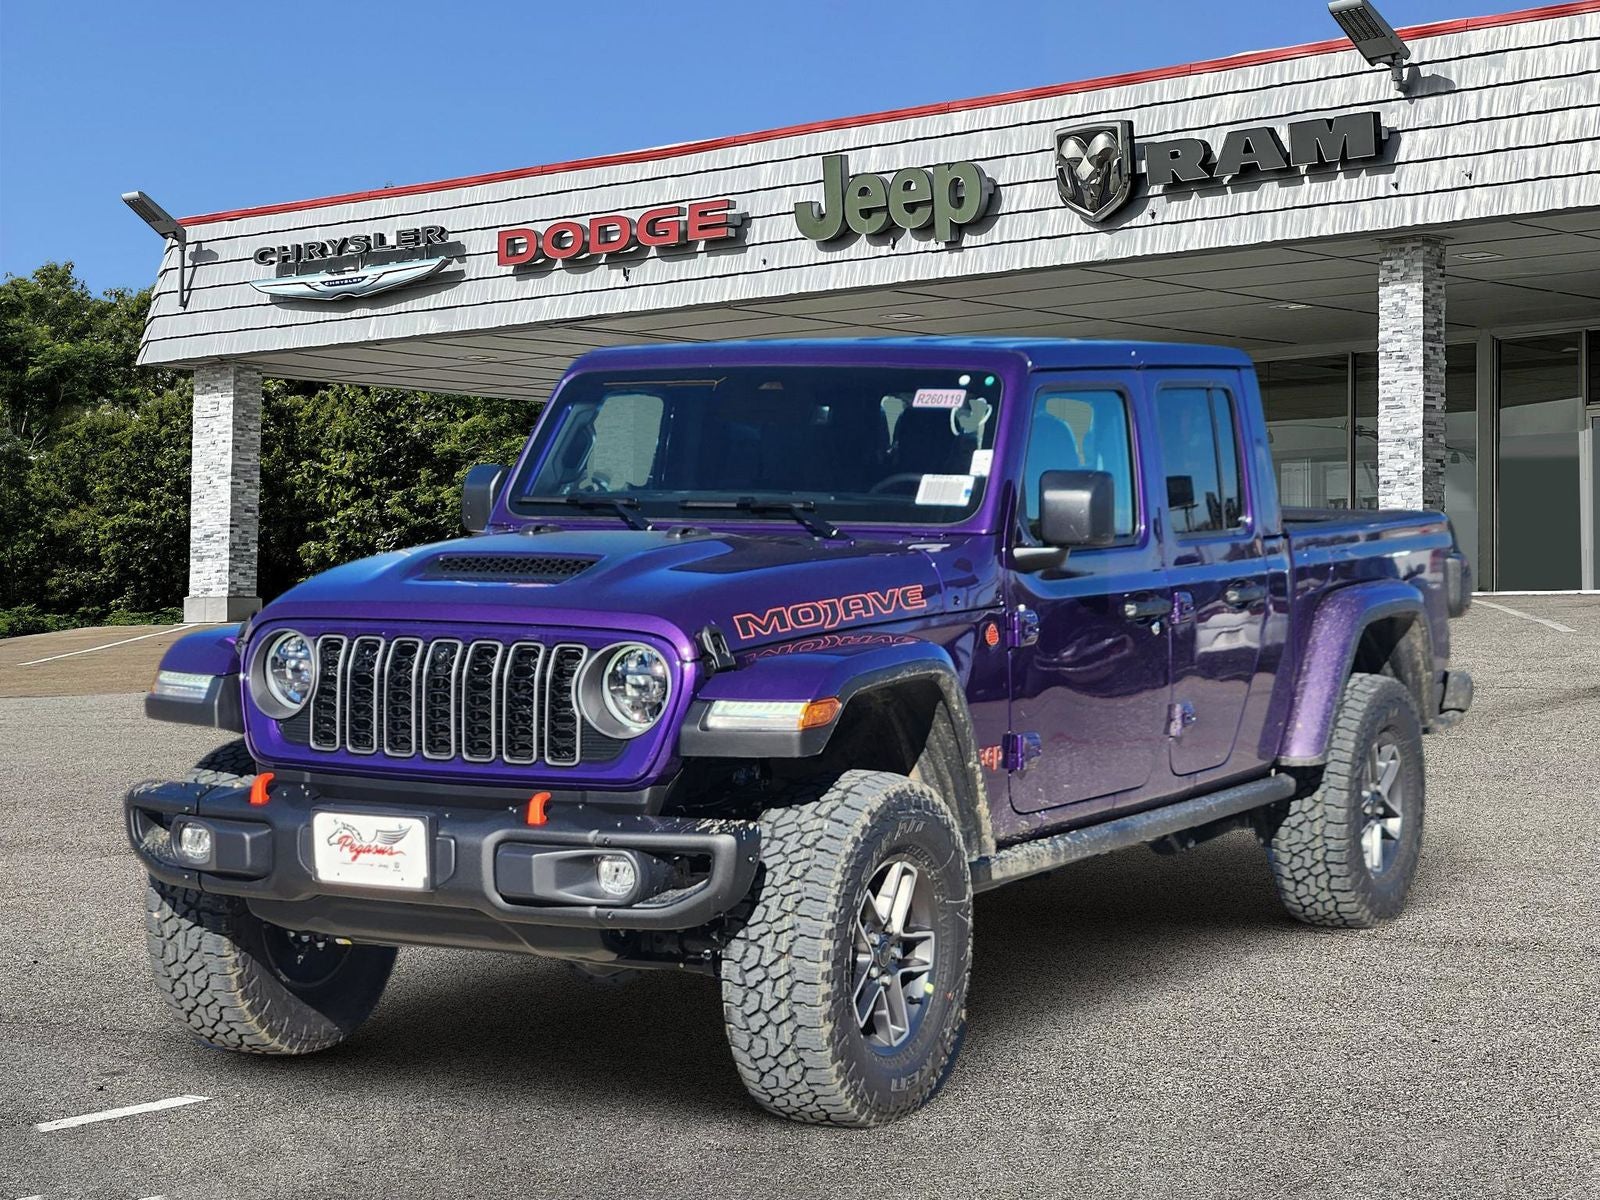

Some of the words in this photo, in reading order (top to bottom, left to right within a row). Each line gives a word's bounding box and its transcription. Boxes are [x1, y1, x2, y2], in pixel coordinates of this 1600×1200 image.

[1147, 111, 1382, 186] RAM
[795, 154, 989, 243] Jeep
[253, 225, 449, 267] CHRYSLER
[497, 199, 737, 267] DODGE
[916, 393, 962, 405] R260119
[733, 584, 927, 640] MOJAVE
[338, 835, 406, 861] Pegasus
